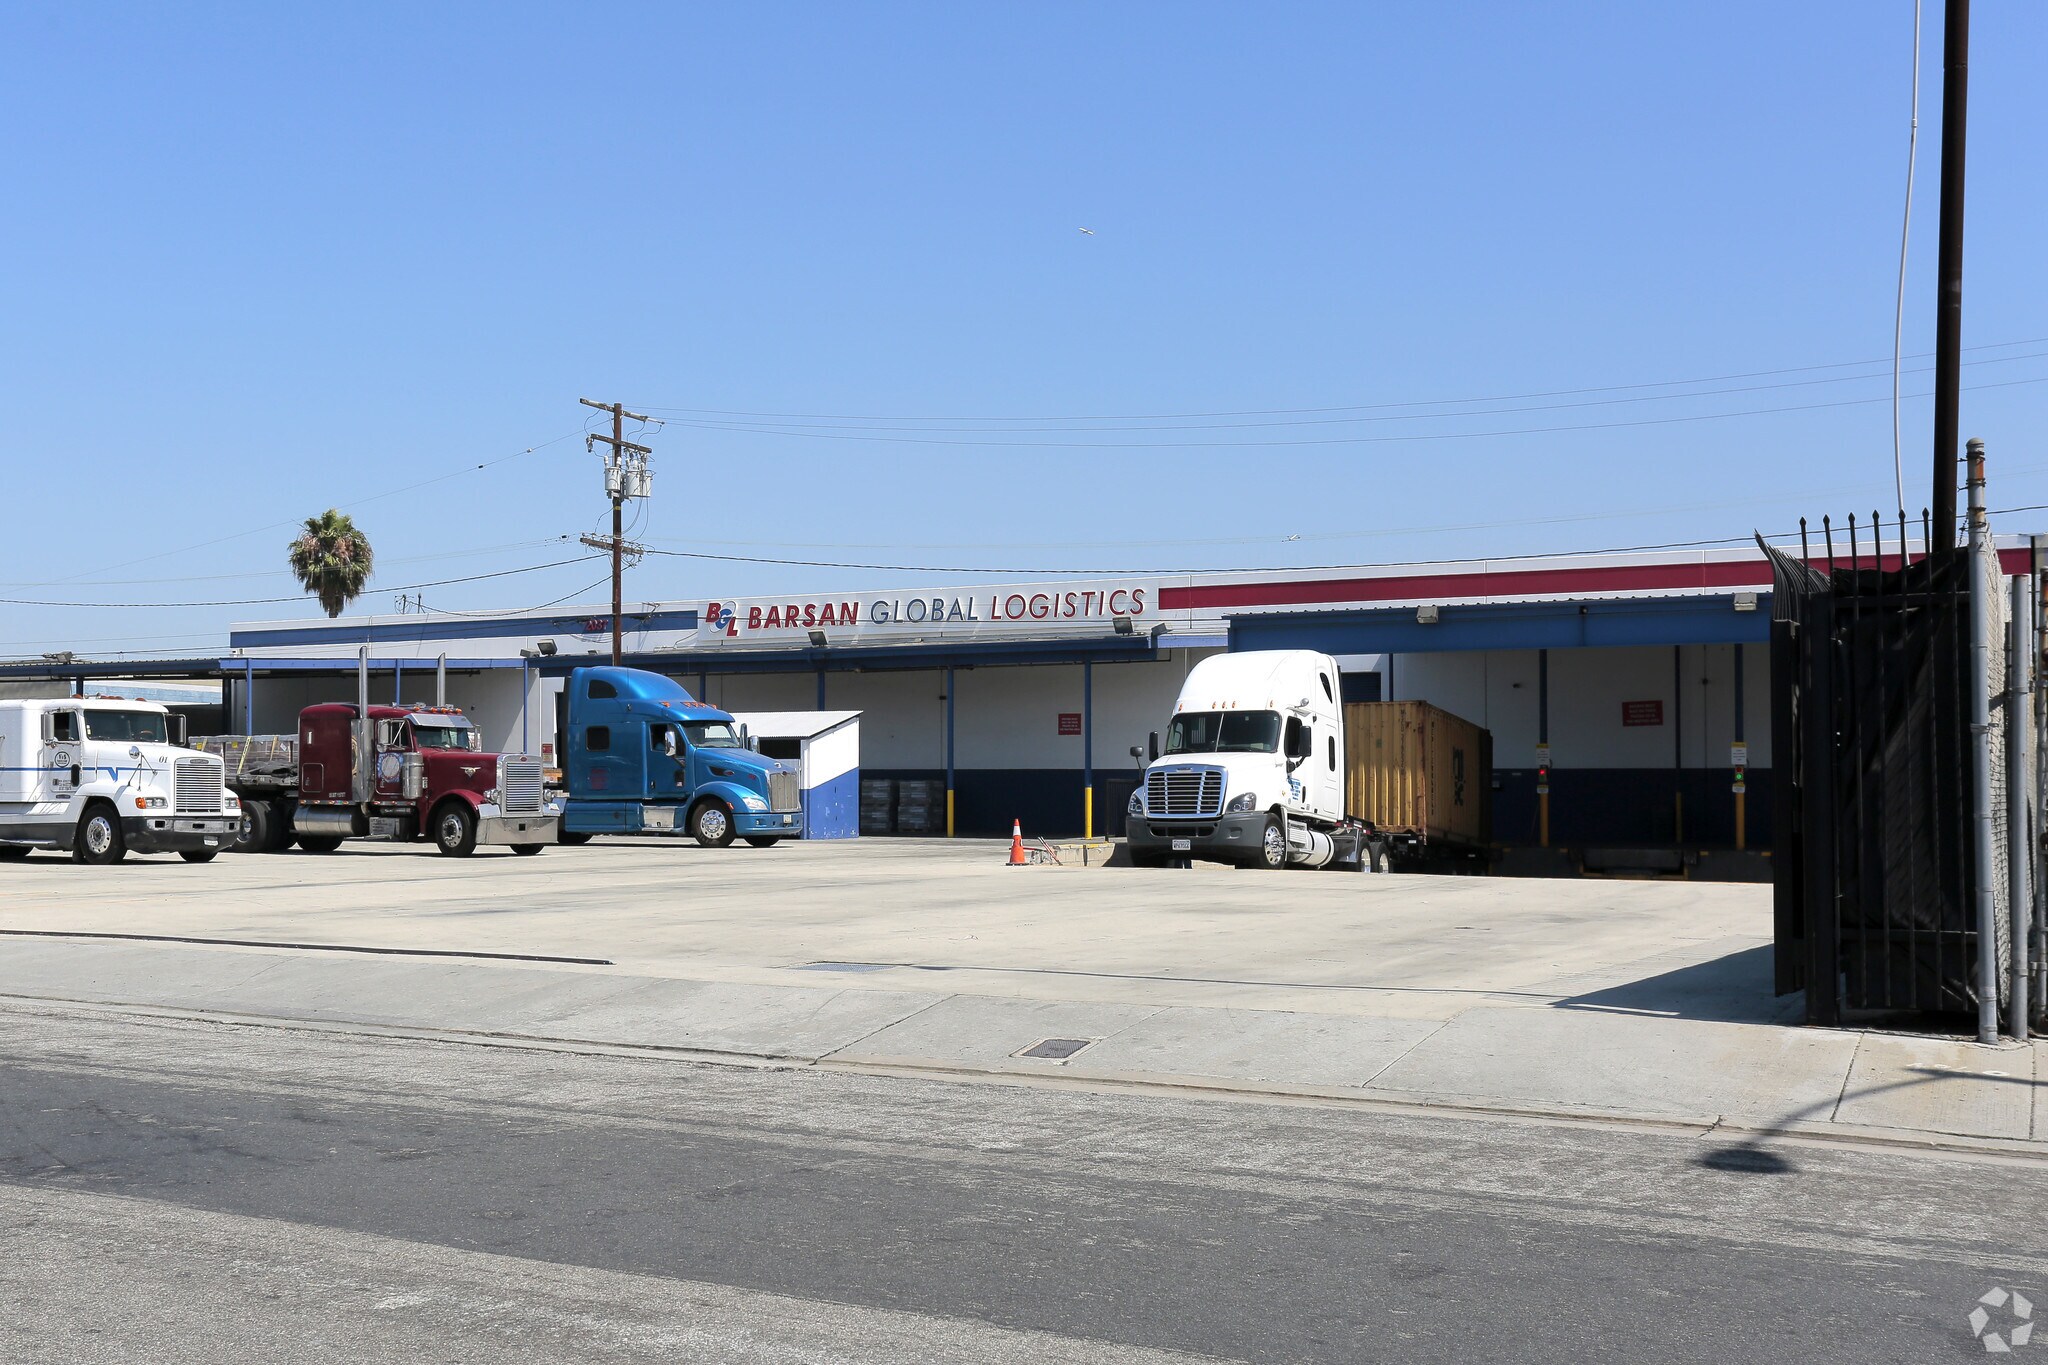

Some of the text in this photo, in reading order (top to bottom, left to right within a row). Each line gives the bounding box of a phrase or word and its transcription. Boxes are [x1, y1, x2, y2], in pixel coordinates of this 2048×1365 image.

[747, 601, 860, 630] BARSAN
[870, 596, 979, 625] GLOBAL
[990, 588, 1146, 620] LOGISTICS
